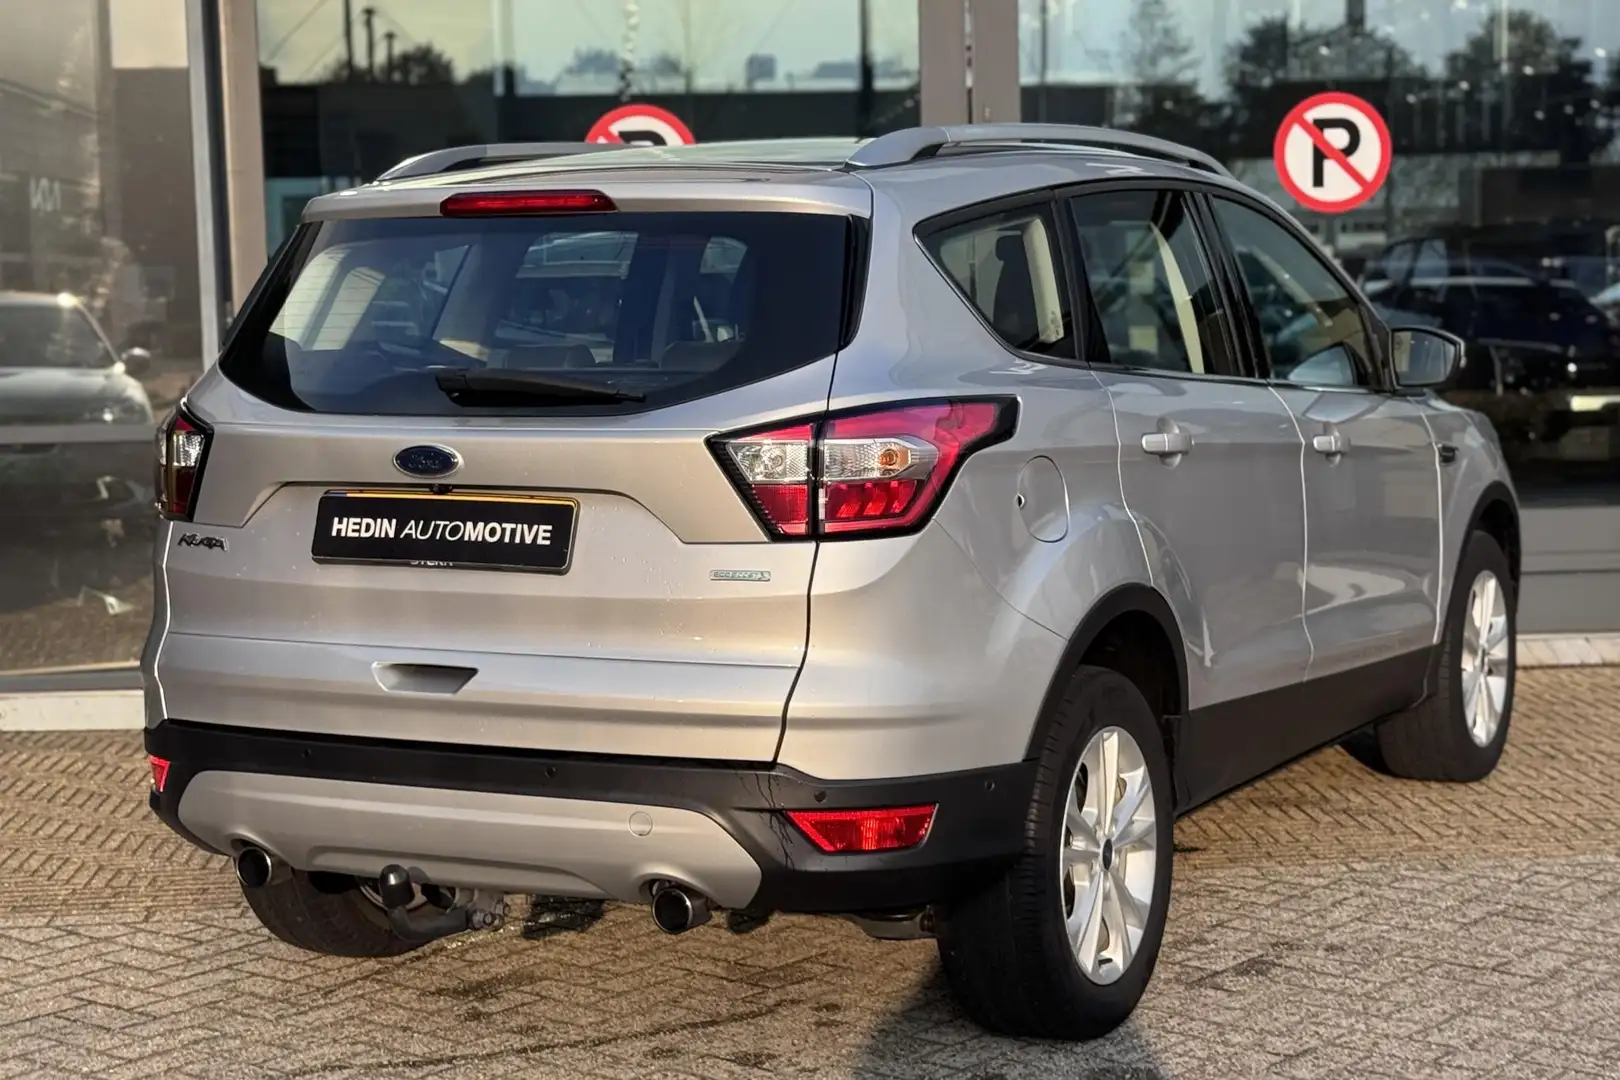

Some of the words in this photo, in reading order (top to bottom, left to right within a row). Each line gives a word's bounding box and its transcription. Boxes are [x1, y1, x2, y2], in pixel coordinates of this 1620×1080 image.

[1313, 118, 1360, 187] P
[331, 517, 397, 538] HEDIN
[400, 520, 553, 546] AUTOMOTIVE
